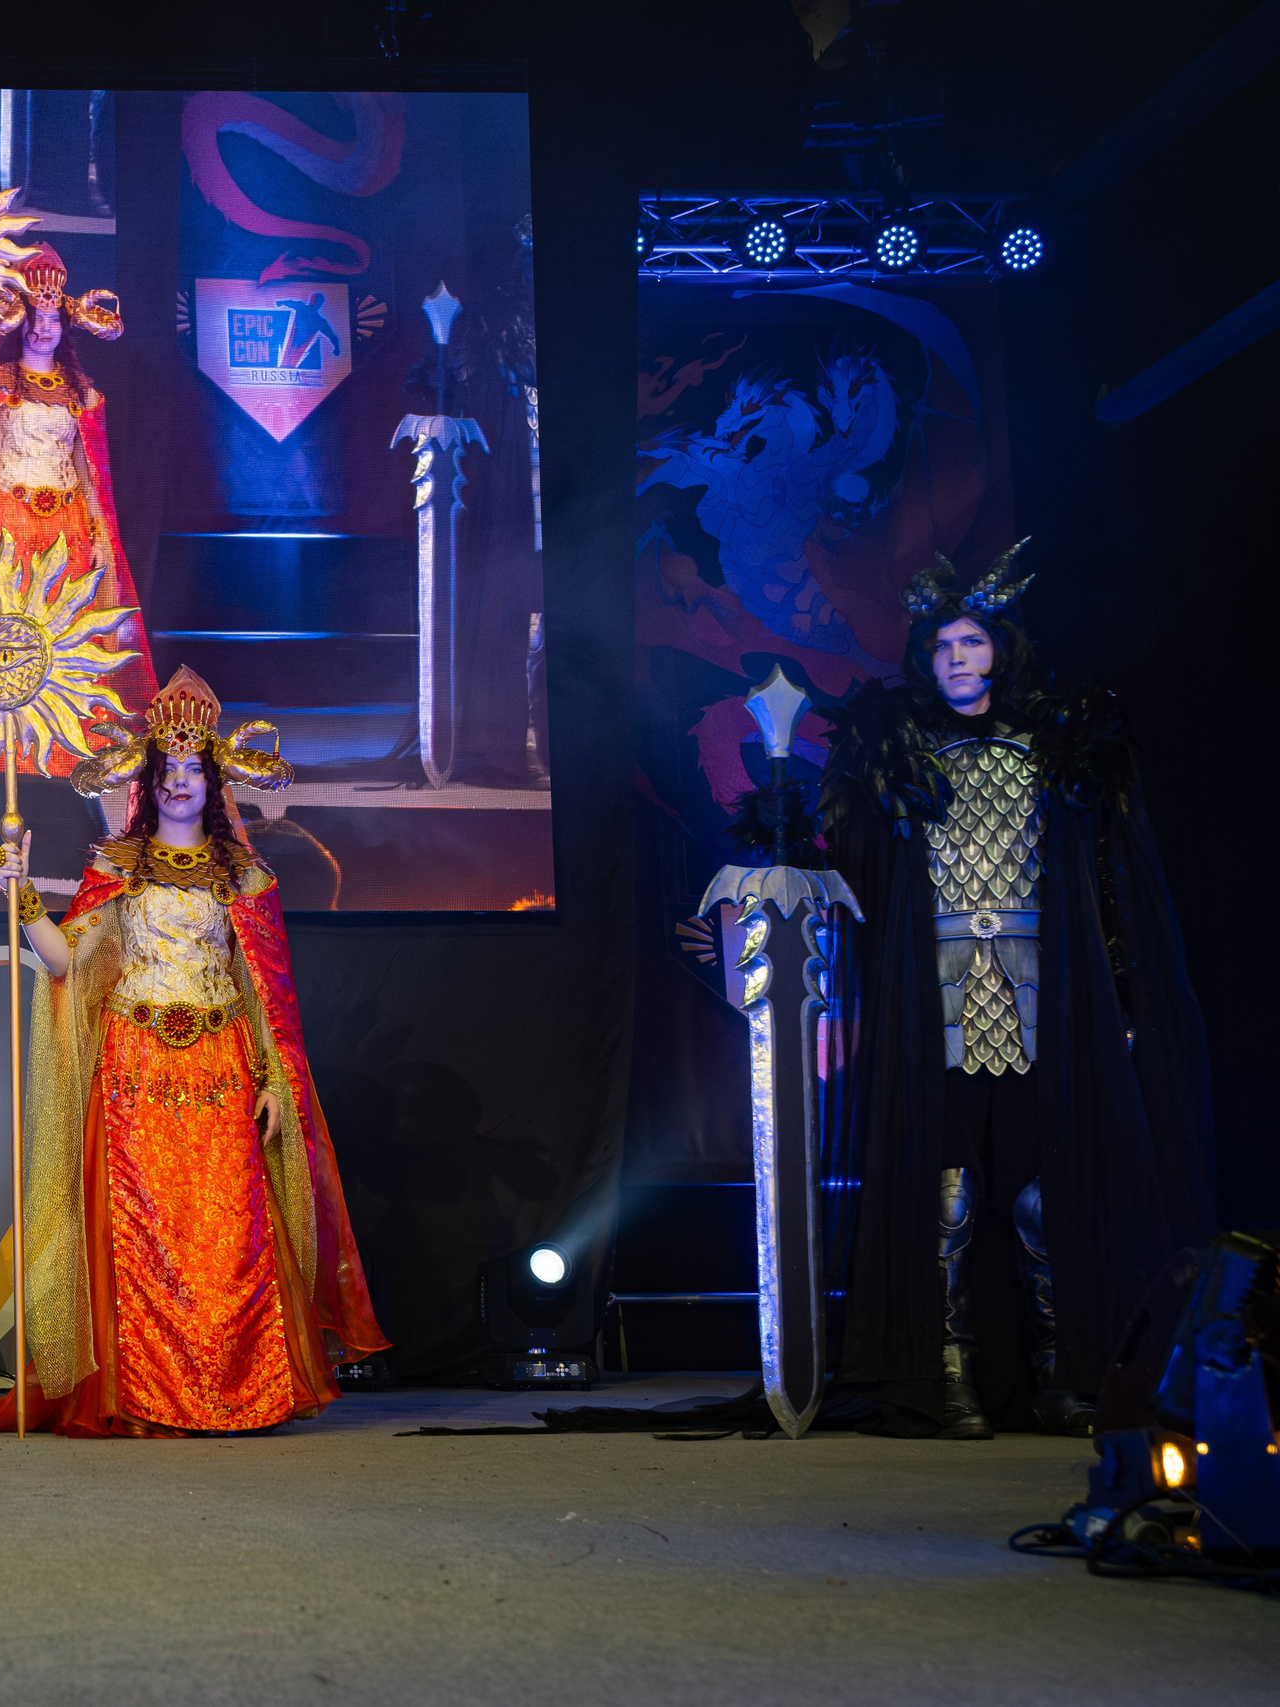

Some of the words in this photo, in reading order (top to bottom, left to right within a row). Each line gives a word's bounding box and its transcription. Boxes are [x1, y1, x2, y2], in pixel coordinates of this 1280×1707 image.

[233, 314, 273, 337] EPIC
[235, 340, 270, 362] CON
[251, 370, 302, 382] RUSSIA
